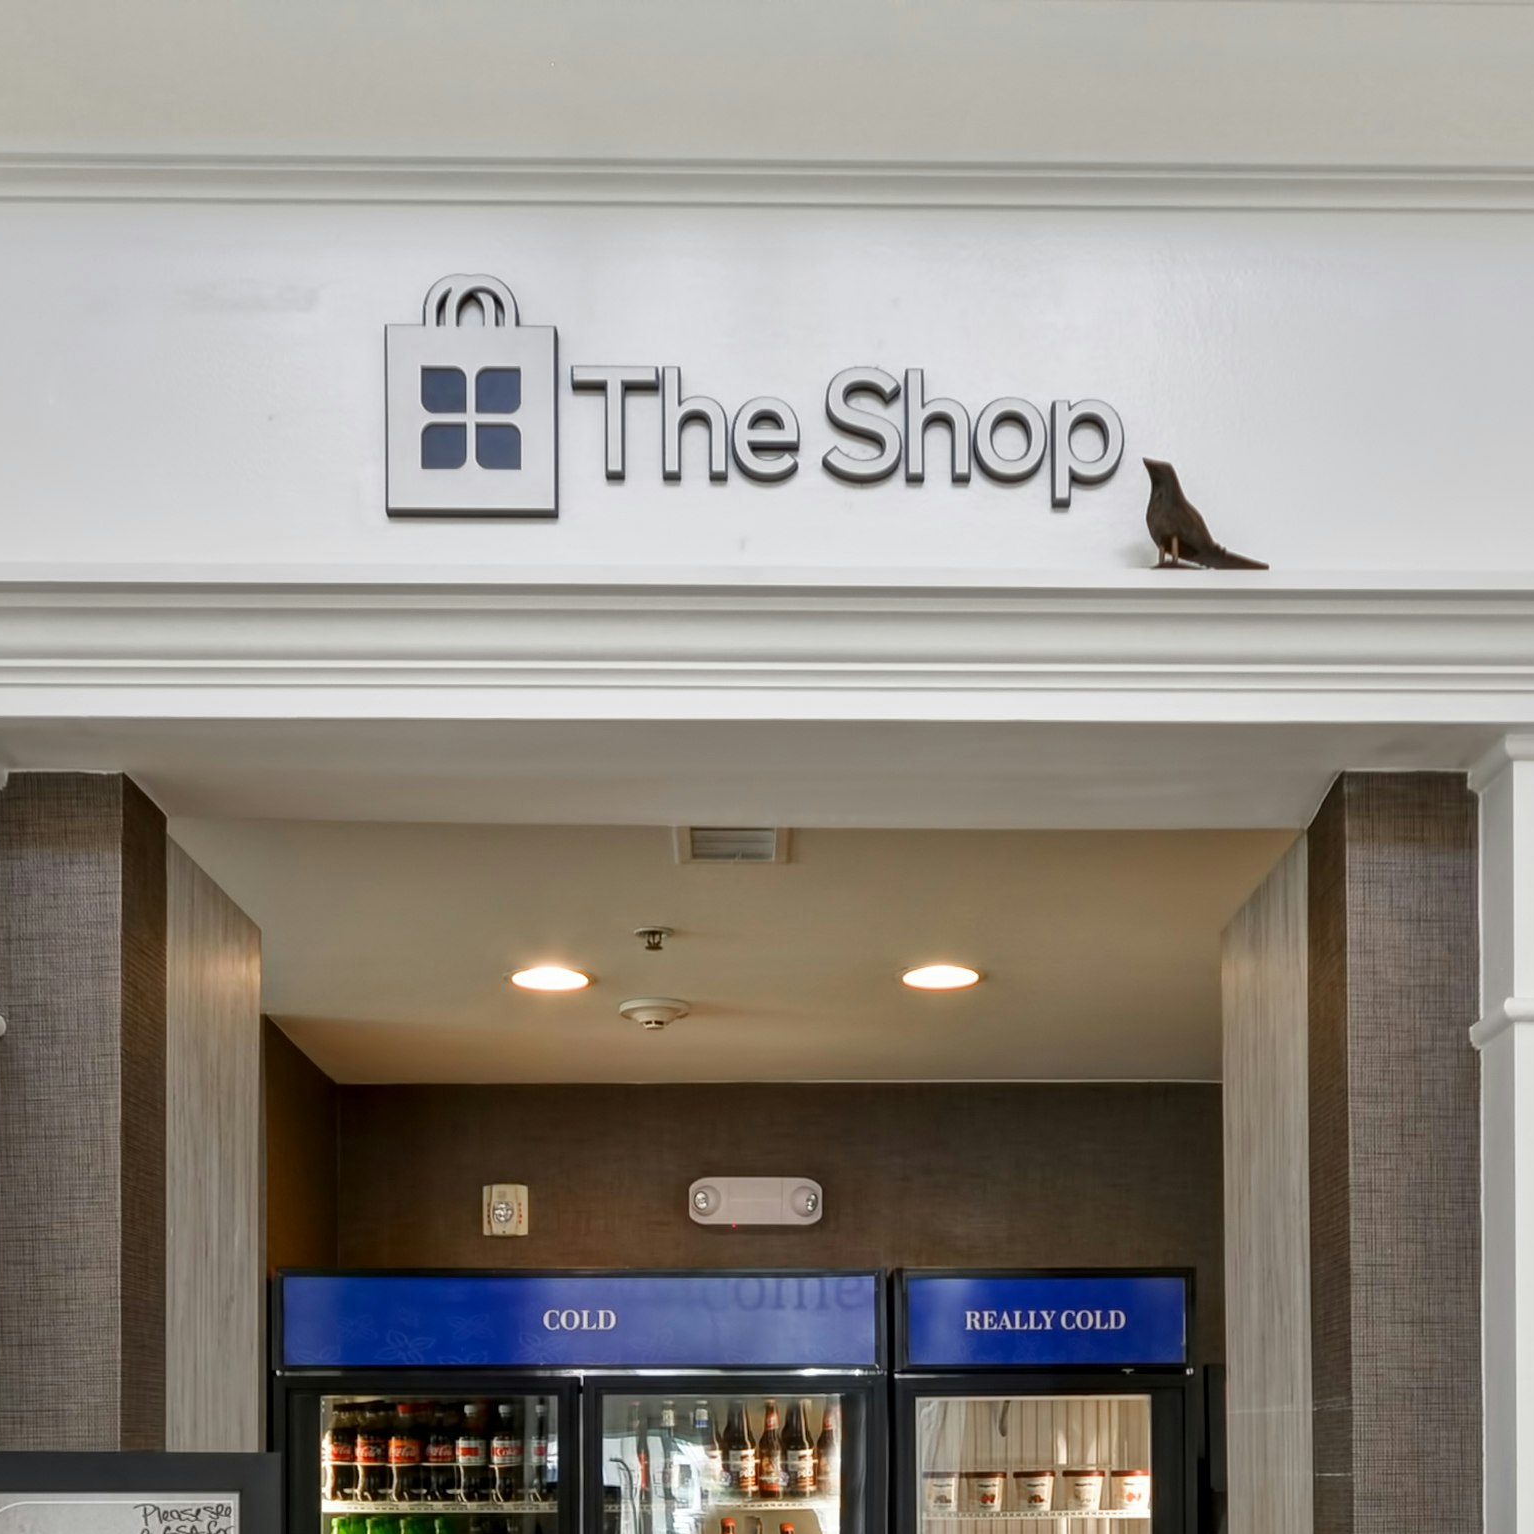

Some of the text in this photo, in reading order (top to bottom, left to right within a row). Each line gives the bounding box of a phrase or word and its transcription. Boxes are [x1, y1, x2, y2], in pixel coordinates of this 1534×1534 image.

[571, 365, 1125, 508] The Shop
[543, 1309, 617, 1331] COLD
[965, 1310, 1126, 1330] REALLY COLD
[133, 1504, 231, 1526] Please see
